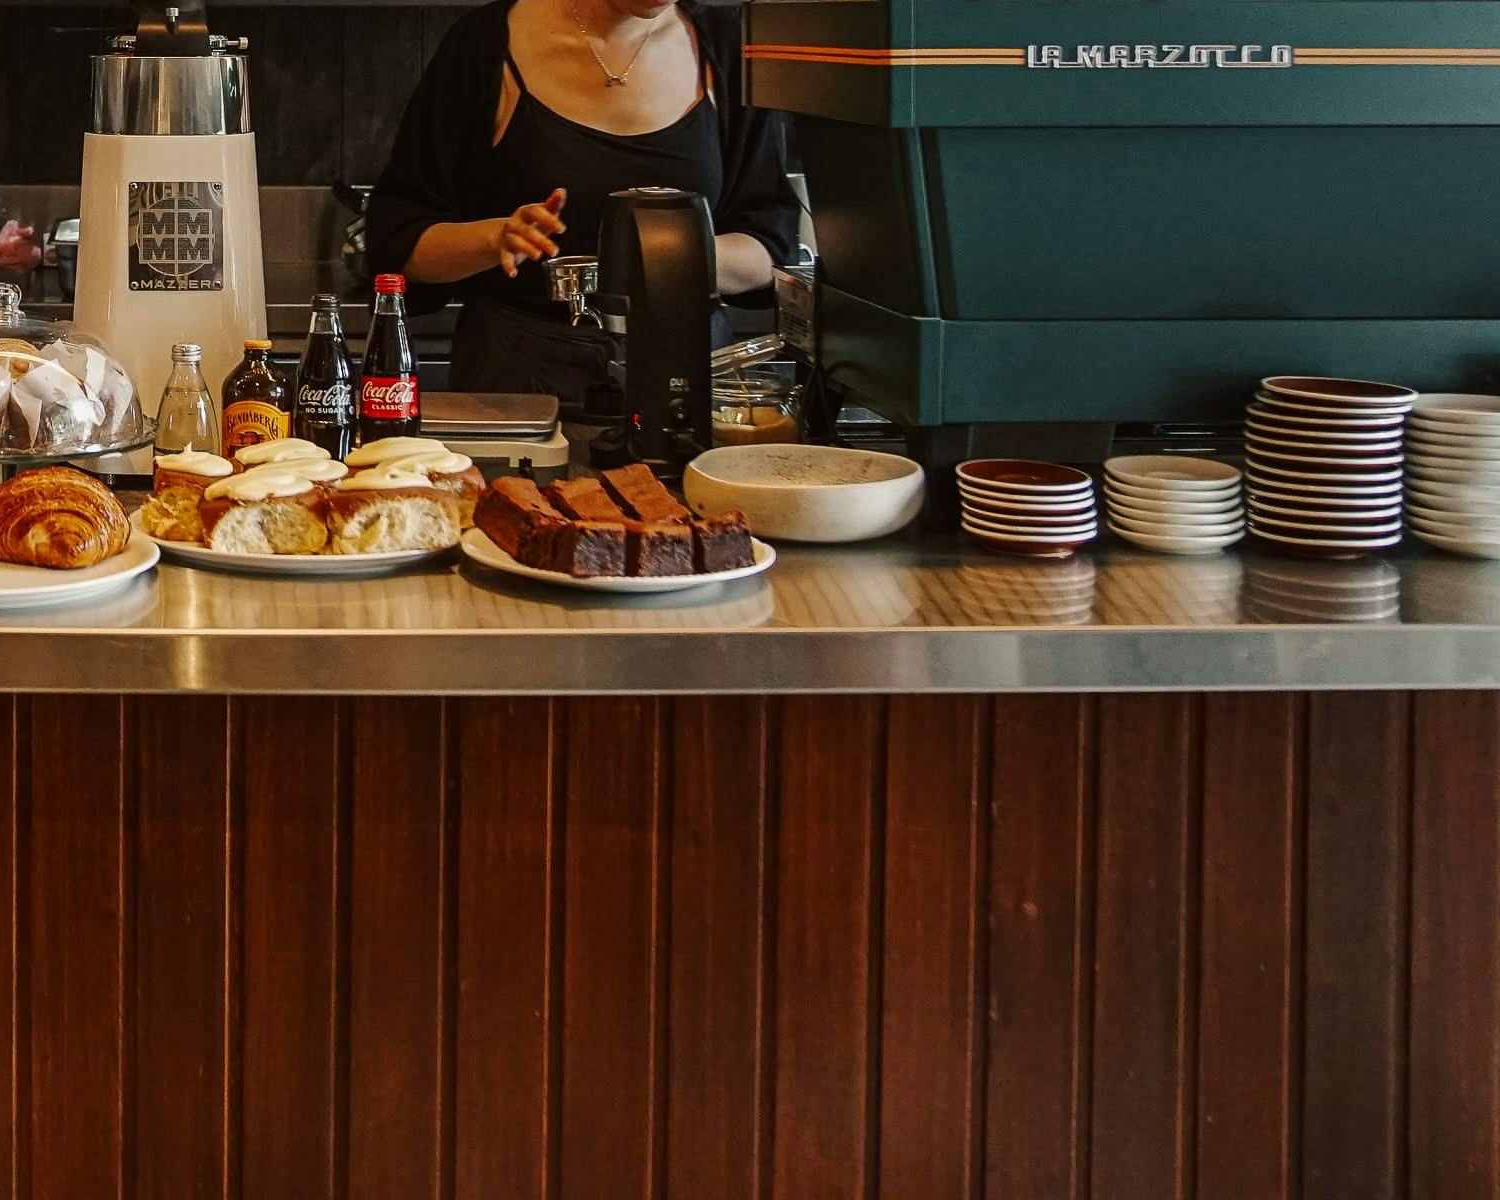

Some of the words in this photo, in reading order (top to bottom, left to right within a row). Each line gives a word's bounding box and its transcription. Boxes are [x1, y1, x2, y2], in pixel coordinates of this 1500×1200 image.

[1028, 45, 1063, 68] LA
[140, 279, 211, 290] MAZZER
[298, 384, 352, 407] Coca-Cola
[362, 381, 416, 404] Coca-Cola
